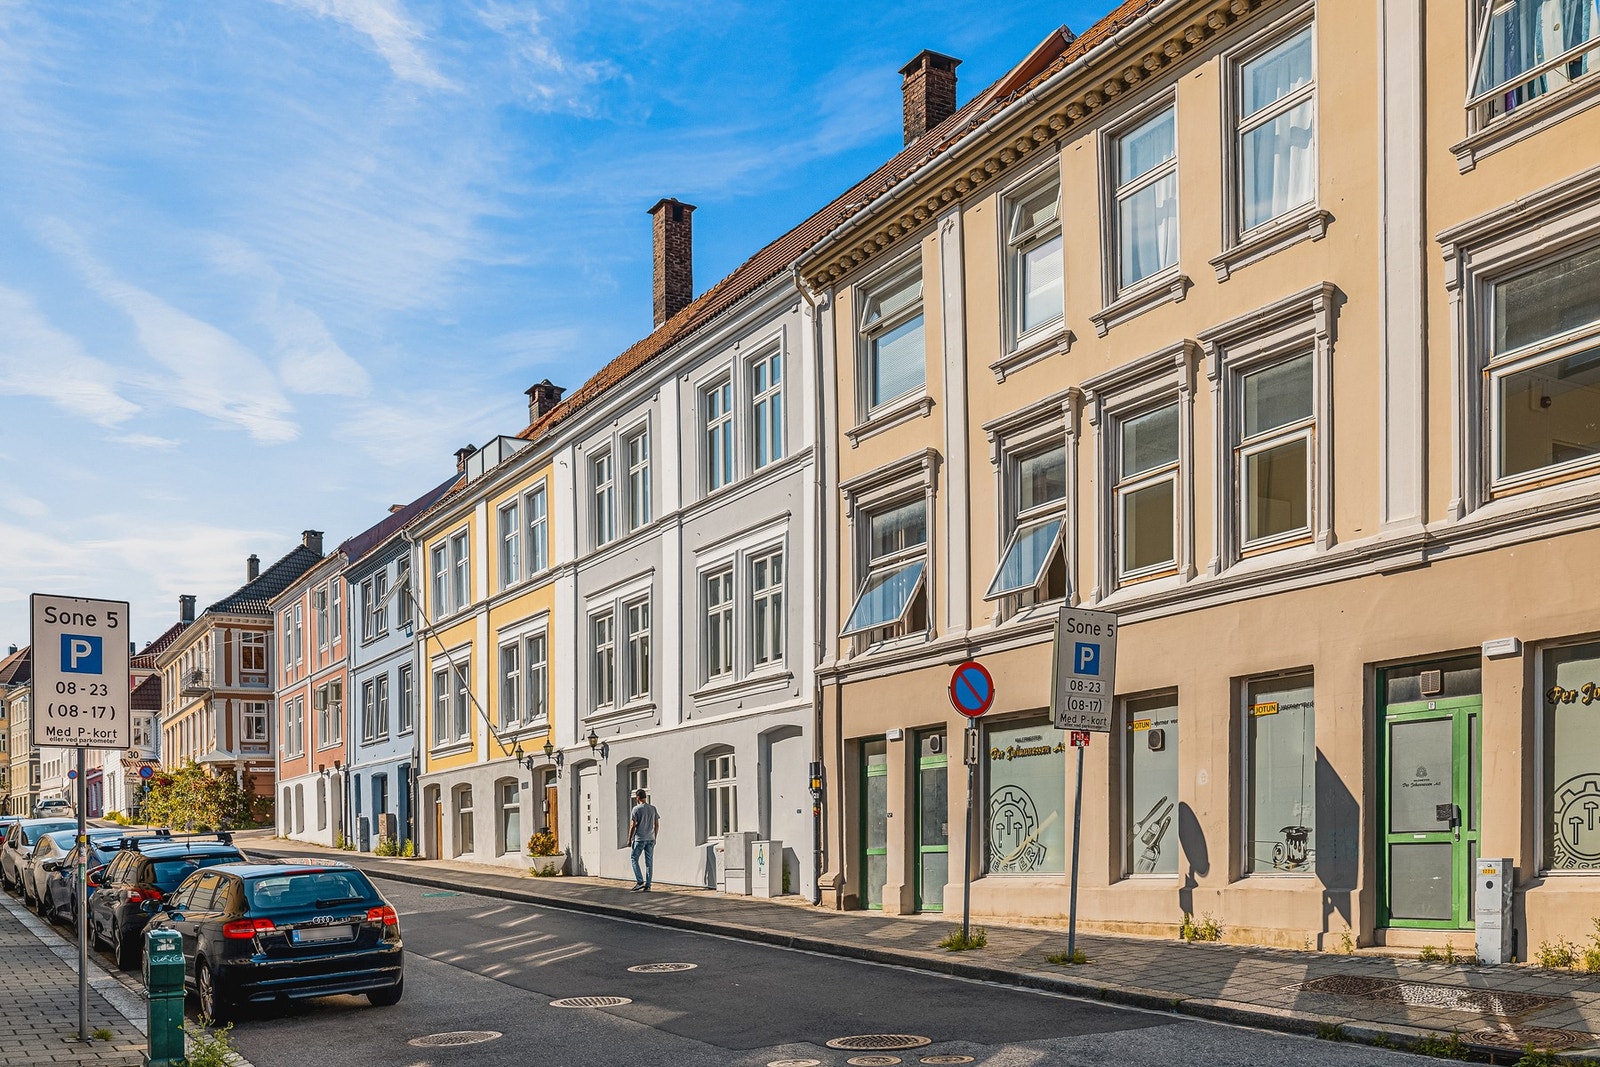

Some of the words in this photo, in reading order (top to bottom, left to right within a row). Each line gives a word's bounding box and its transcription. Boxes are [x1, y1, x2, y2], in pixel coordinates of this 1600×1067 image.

[44, 606, 97, 627] Sone
[106, 611, 118, 629] 5
[1066, 617, 1101, 636] Sone
[1107, 624, 1114, 637] 5
[70, 639, 92, 669] P
[1080, 646, 1094, 670] P
[1070, 680, 1101, 693] 08-23
[1546, 685, 1579, 705] Per
[1067, 696, 1102, 713] (08-17)
[1255, 704, 1276, 714] JOTUN
[1060, 713, 1077, 723] Med
[1080, 715, 1107, 726] P-kort
[46, 726, 71, 737] Med
[78, 727, 118, 739] P-kort
[128, 751, 139, 759] 30
